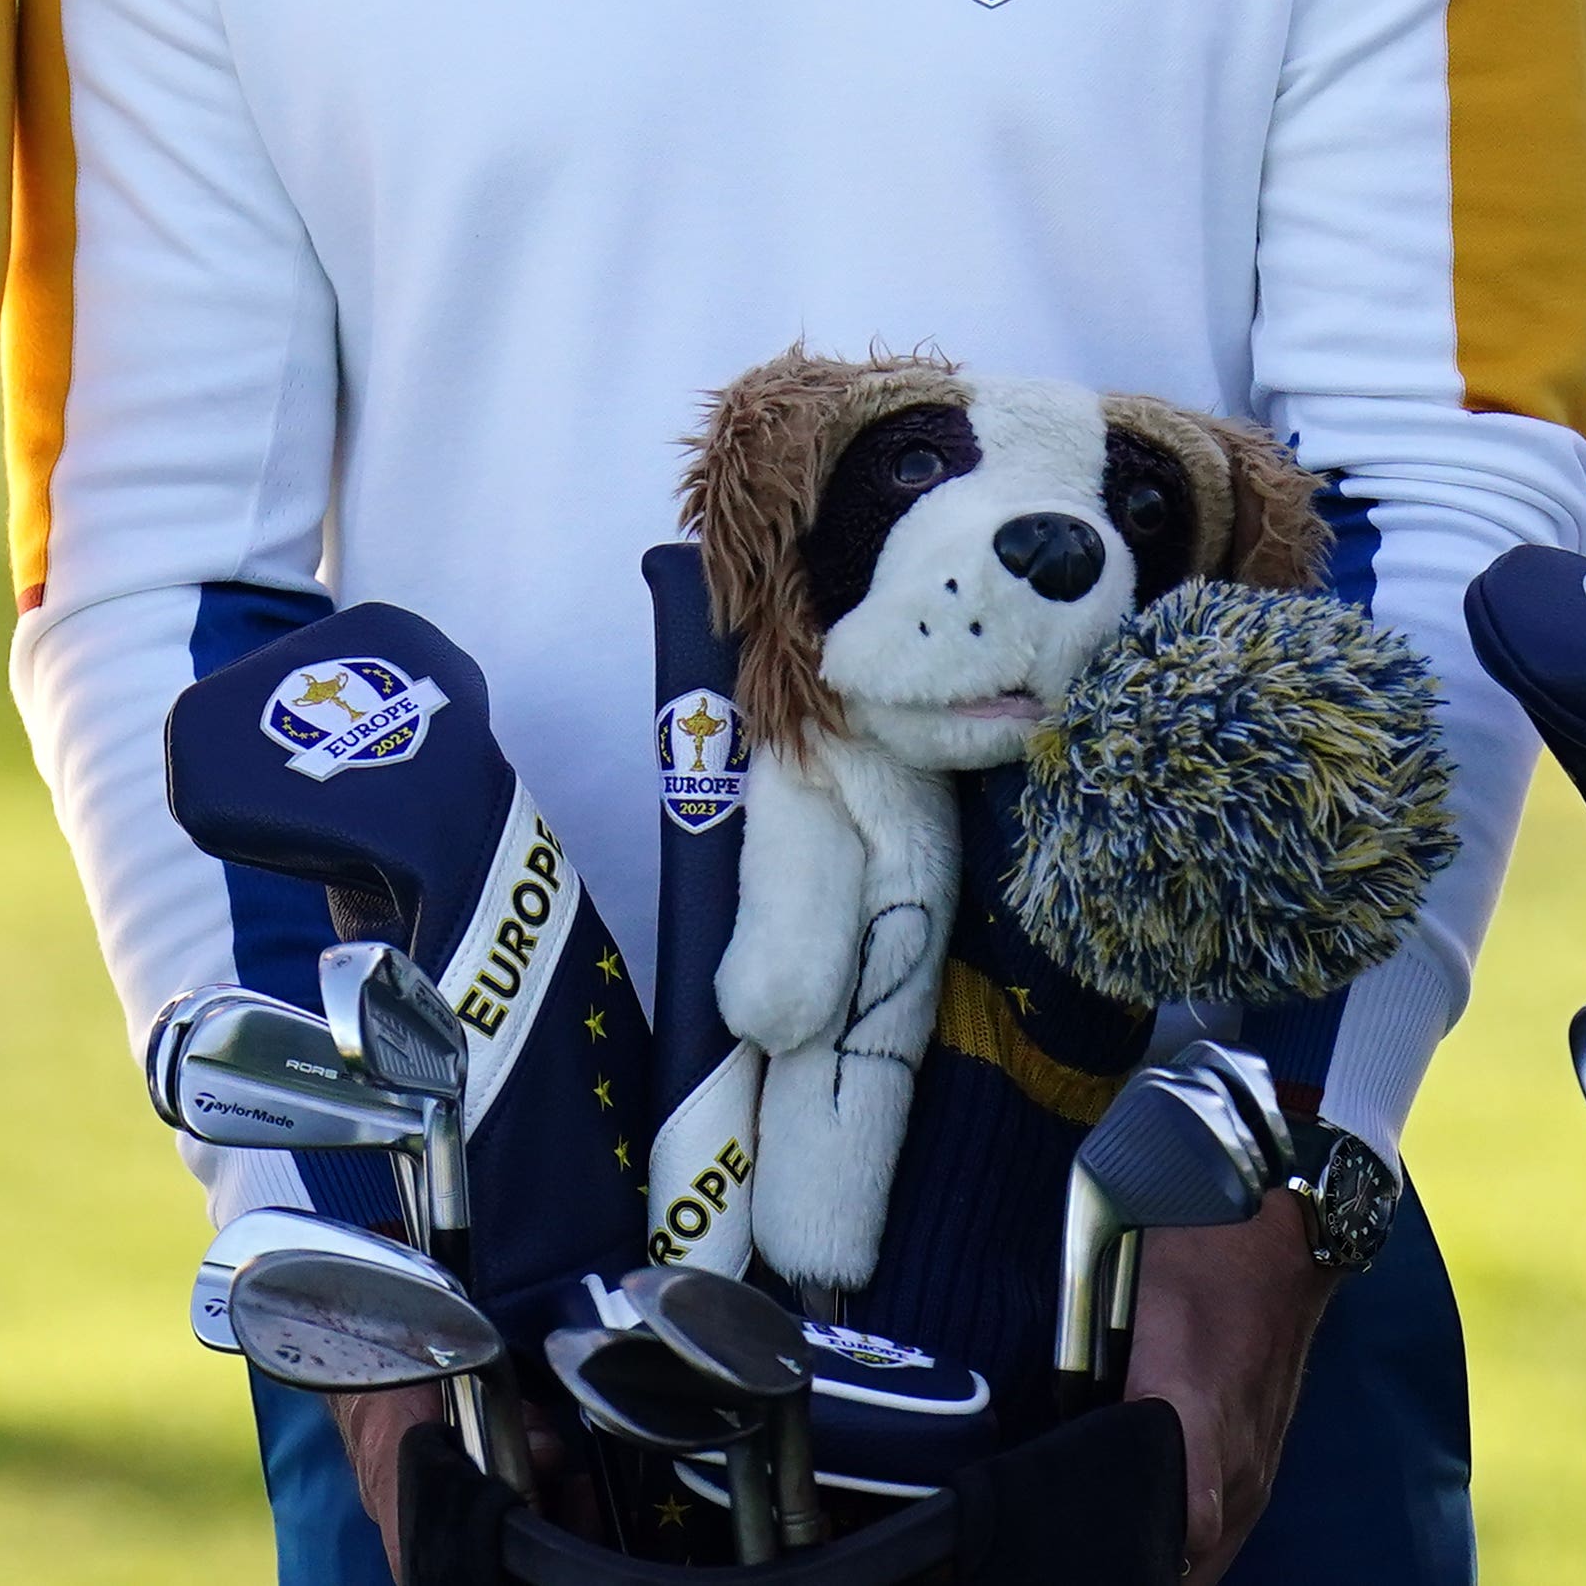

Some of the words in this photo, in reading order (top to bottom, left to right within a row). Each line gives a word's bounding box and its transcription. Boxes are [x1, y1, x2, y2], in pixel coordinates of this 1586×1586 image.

[323, 697, 419, 759] EUROPE
[371, 727, 414, 757] 2023
[664, 776, 741, 795] EUROPE
[679, 803, 717, 816] 2023
[454, 815, 565, 1041] EUROPE
[194, 1092, 295, 1130] TaylorMade
